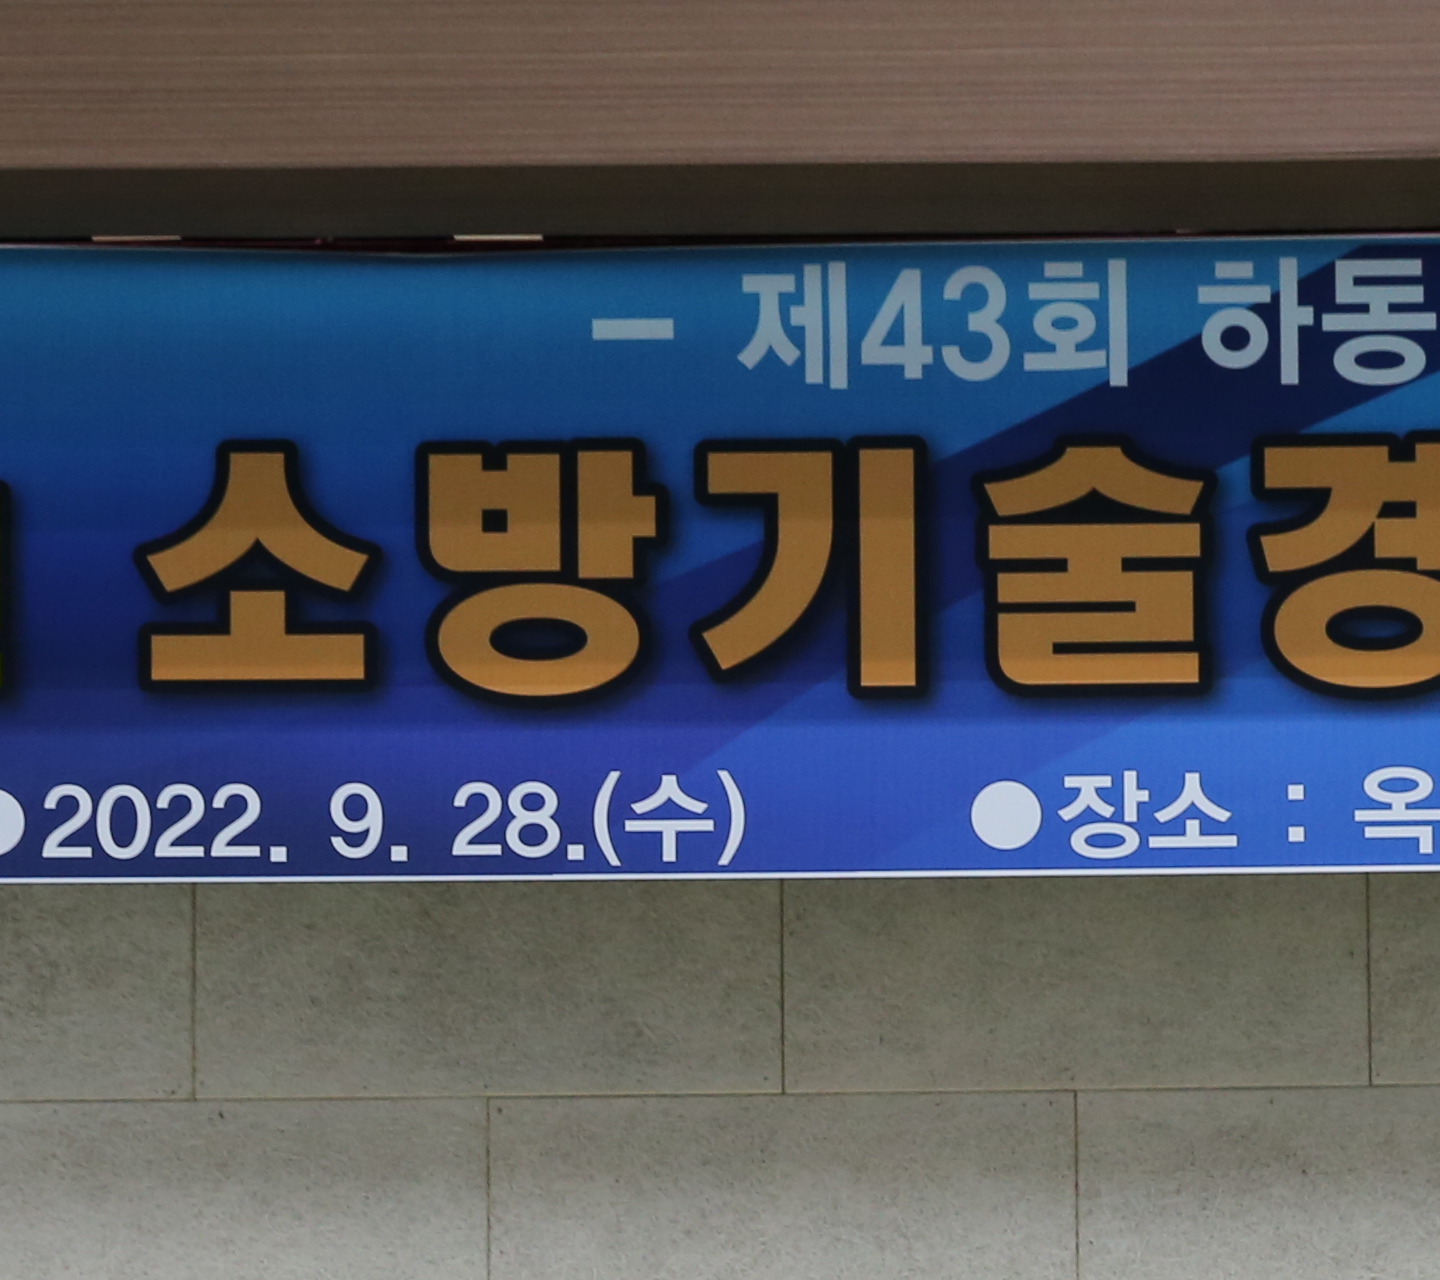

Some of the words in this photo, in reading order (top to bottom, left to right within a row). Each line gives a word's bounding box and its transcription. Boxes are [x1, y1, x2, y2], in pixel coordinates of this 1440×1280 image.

[738, 259, 1129, 389] 제43회
[40, 783, 287, 861] 2022.
[330, 783, 408, 861] 9.
[454, 767, 747, 866] 28.(수)
[1058, 770, 1237, 853] 장소
